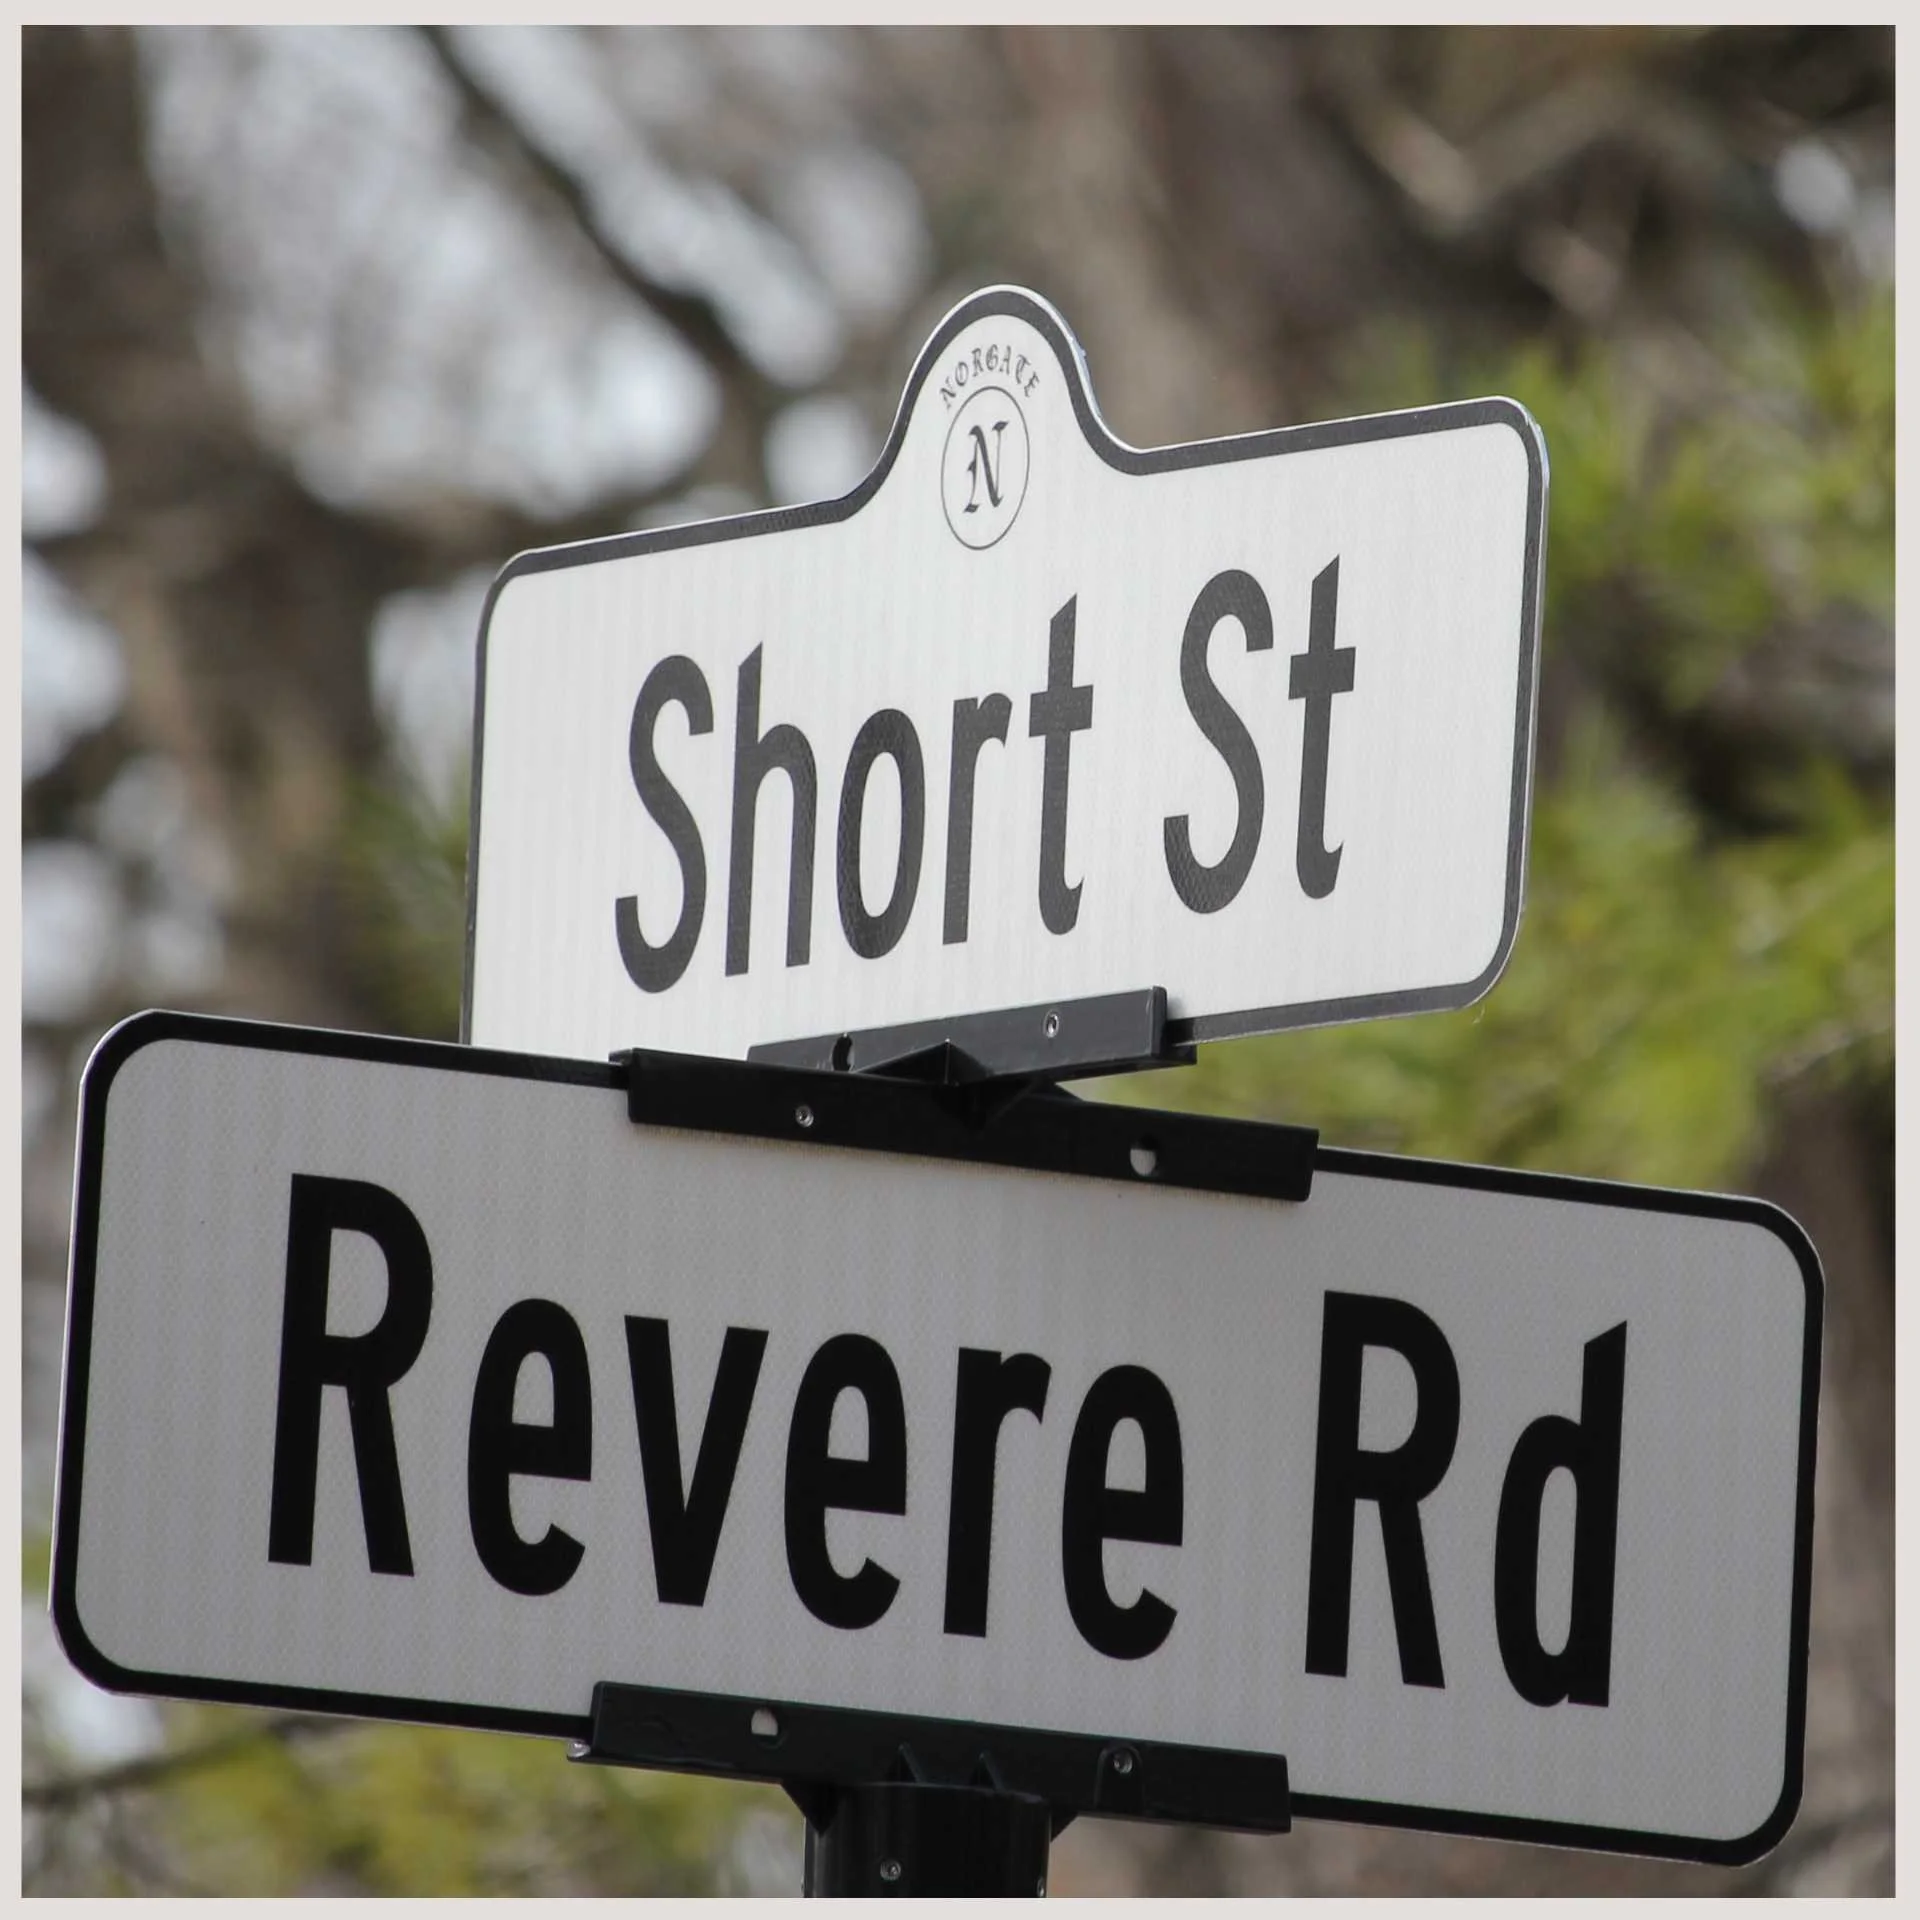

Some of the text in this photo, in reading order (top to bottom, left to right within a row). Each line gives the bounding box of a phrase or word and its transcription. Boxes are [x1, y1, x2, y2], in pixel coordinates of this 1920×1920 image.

[939, 344, 1040, 409] NORGATE
[963, 420, 1009, 514] N
[615, 555, 1356, 994] Short St
[267, 1172, 1628, 1708] Revere Rd
